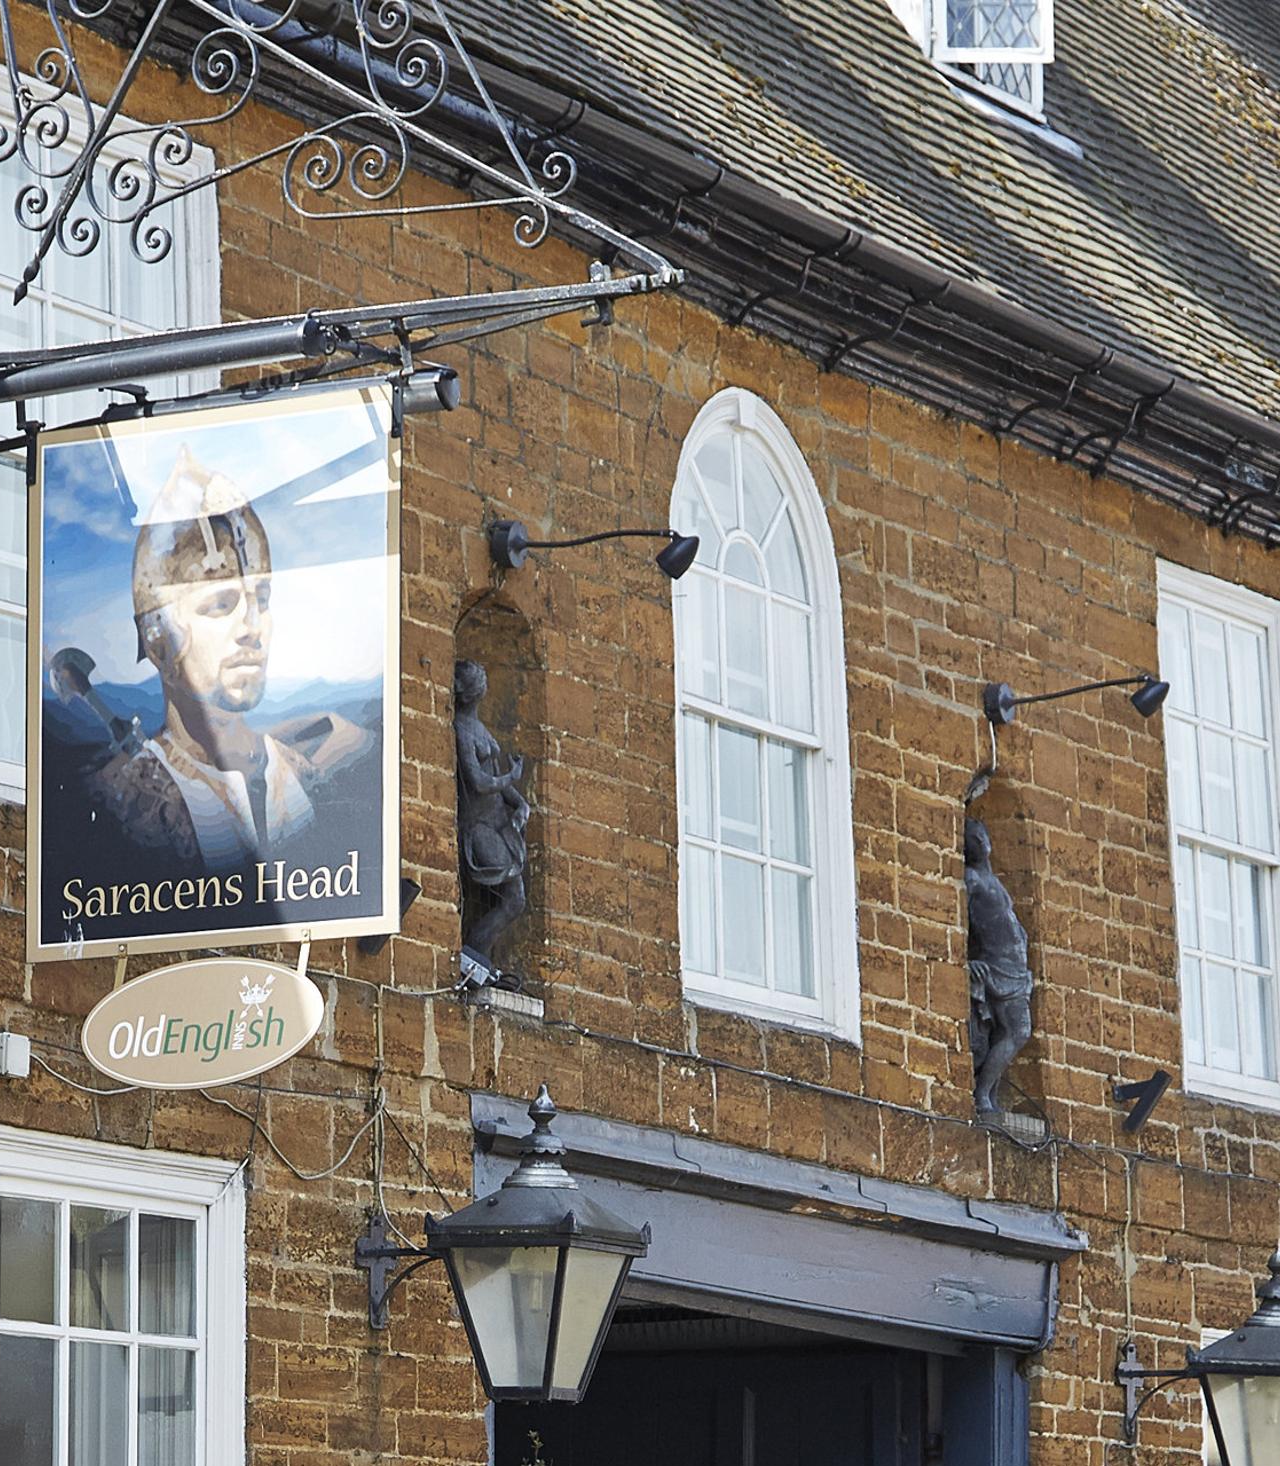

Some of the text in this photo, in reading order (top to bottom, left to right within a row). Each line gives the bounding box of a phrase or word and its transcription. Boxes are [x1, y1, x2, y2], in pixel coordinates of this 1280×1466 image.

[62, 850, 361, 920] Saracens Head
[231, 1022, 247, 1050] INNS
